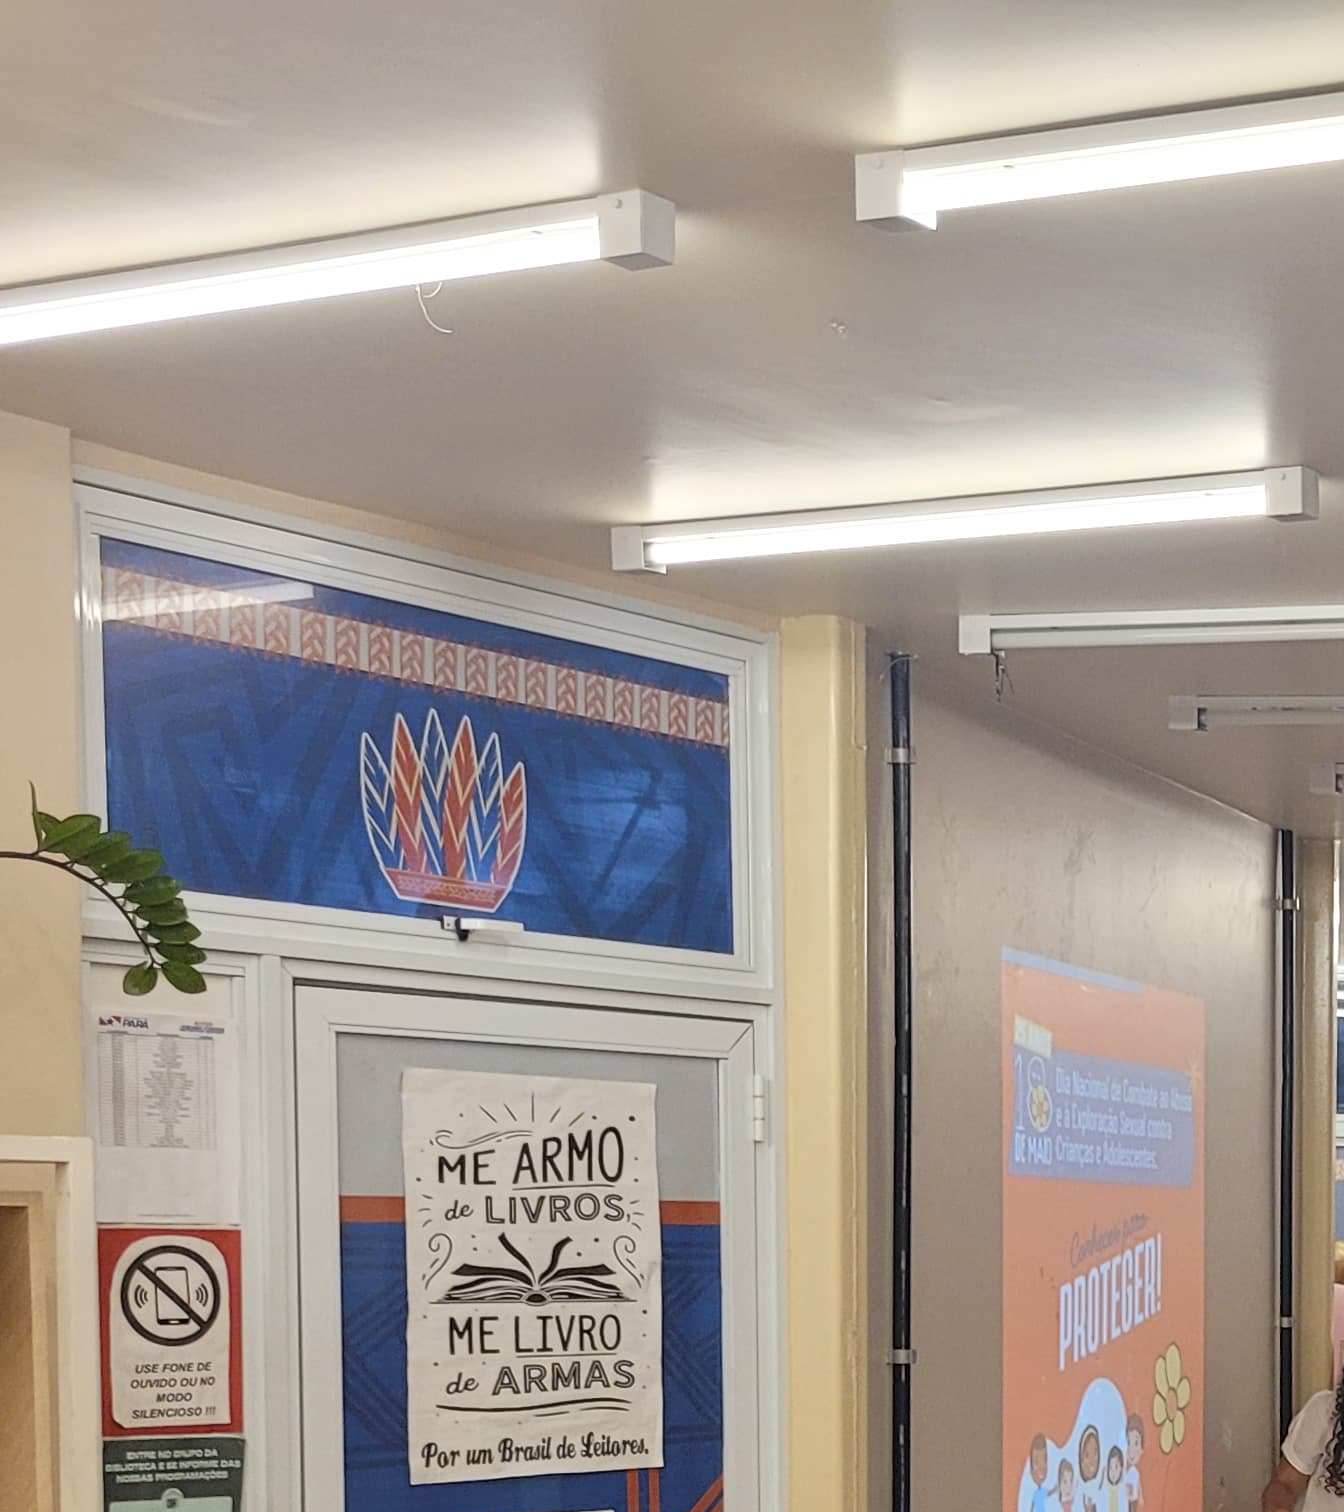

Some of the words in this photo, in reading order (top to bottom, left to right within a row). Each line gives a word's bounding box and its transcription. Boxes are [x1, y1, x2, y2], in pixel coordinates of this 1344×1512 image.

[437, 1149, 496, 1185] ME
[512, 1126, 625, 1185] ARMO
[444, 1200, 474, 1222] de
[1059, 1232, 1162, 1371] PROTEGER!
[449, 1316, 499, 1355] ME
[514, 1313, 621, 1353] LIVRO
[135, 1363, 159, 1374] USE
[162, 1362, 194, 1373] FONE
[197, 1361, 212, 1372] DE
[130, 1378, 177, 1389] OUVIDO
[180, 1377, 197, 1388] OU
[200, 1376, 215, 1387] NO
[446, 1371, 479, 1395] de
[493, 1359, 635, 1396] ARMAS
[156, 1392, 192, 1403] MODO
[132, 1407, 203, 1419] SILENCIOSO
[126, 1451, 156, 1460] ENTRE
[204, 1448, 219, 1457] DA
[421, 1441, 460, 1470] Por
[466, 1445, 494, 1466] um
[498, 1435, 551, 1465] Brasil
[556, 1433, 576, 1459] de
[220, 1459, 241, 1468] DAS
